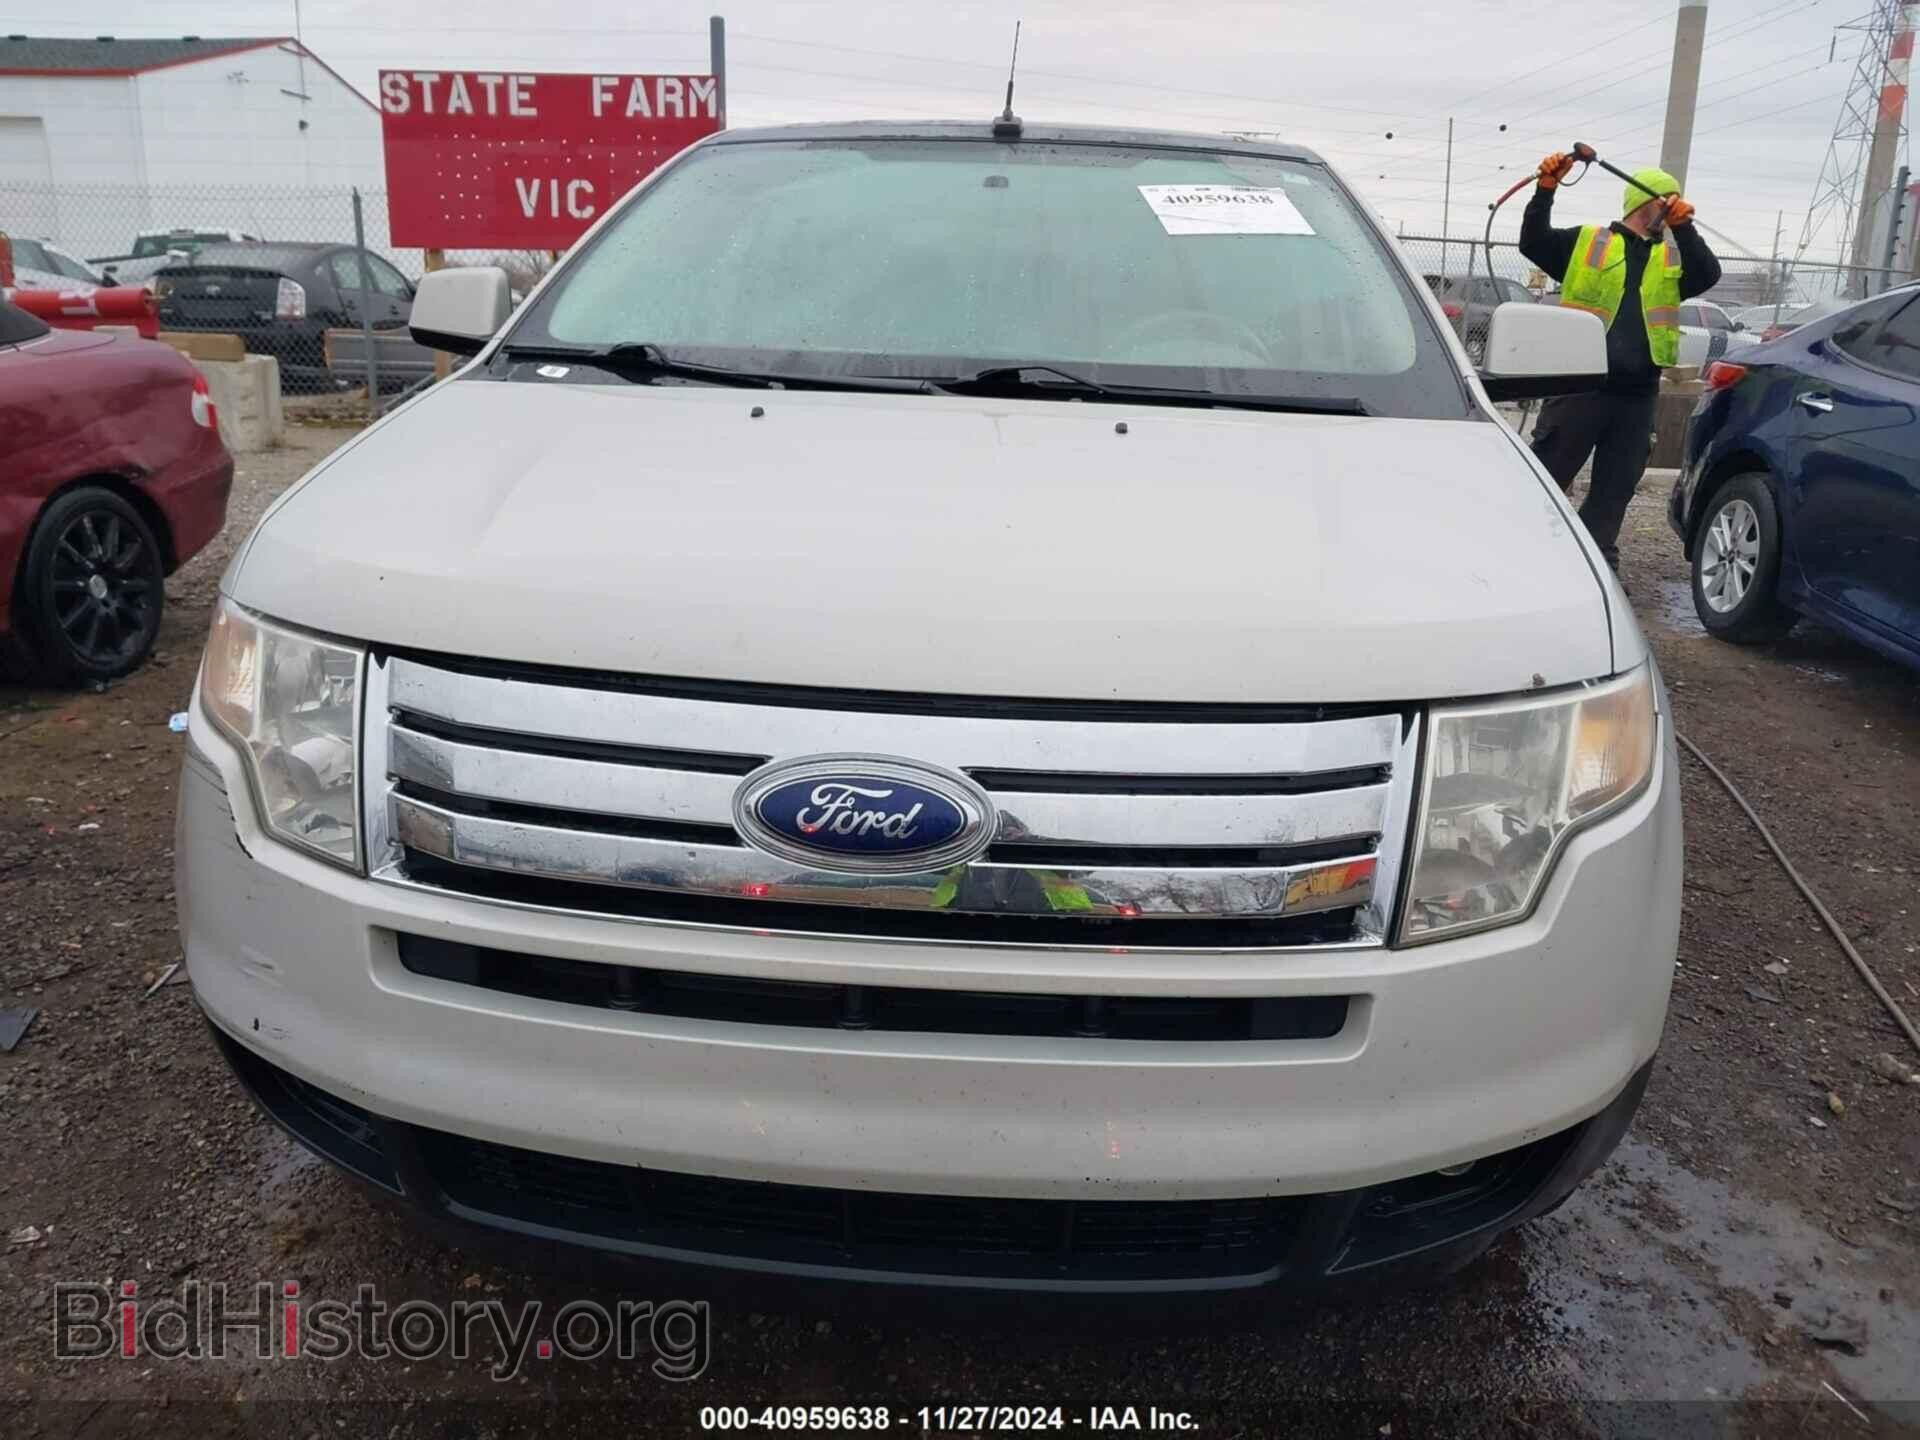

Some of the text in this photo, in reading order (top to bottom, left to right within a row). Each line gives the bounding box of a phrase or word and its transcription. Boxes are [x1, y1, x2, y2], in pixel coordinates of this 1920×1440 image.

[381, 73, 716, 118] STATE FARM
[515, 177, 595, 218] VIC
[1163, 194, 1274, 205] 40959638
[796, 783, 923, 838] Ford
